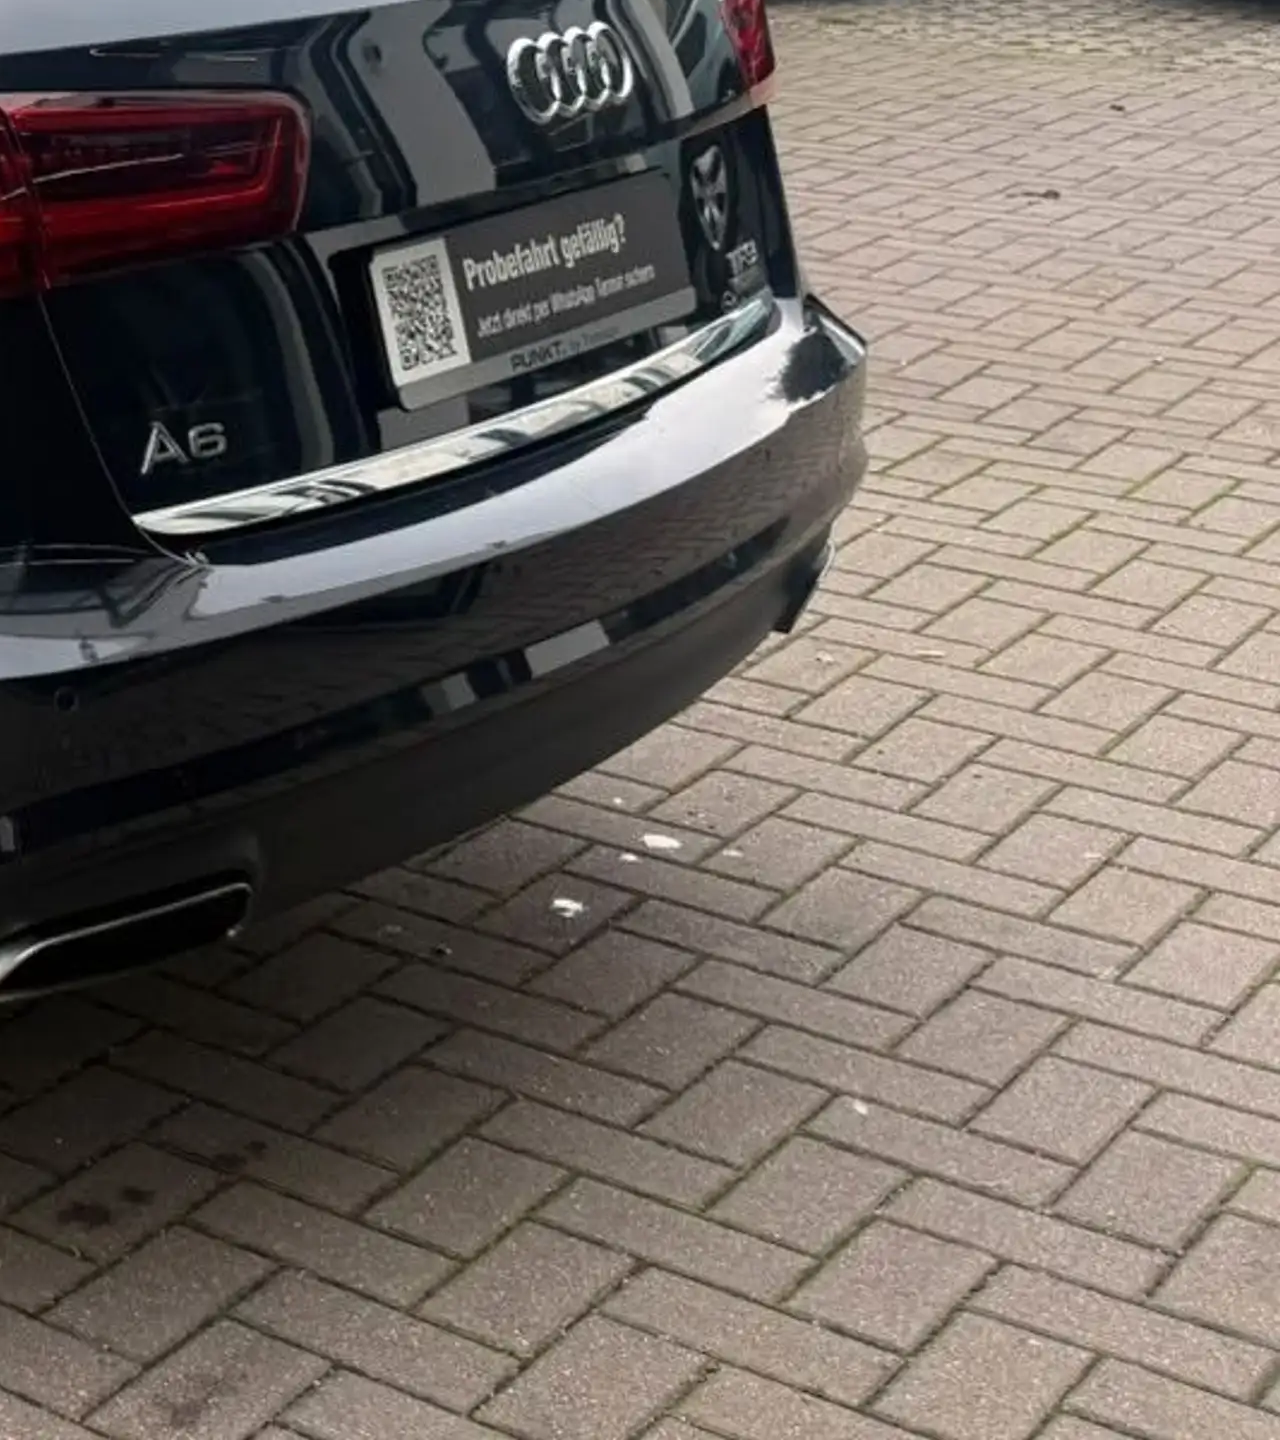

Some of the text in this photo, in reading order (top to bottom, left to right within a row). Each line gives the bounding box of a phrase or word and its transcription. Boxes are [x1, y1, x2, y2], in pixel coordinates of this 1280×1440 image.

[462, 212, 627, 290] Probefahrt gefällig?
[477, 310, 502, 338] Jetzt
[503, 302, 532, 329] direkt
[533, 299, 550, 323] per
[141, 421, 228, 475] A6
